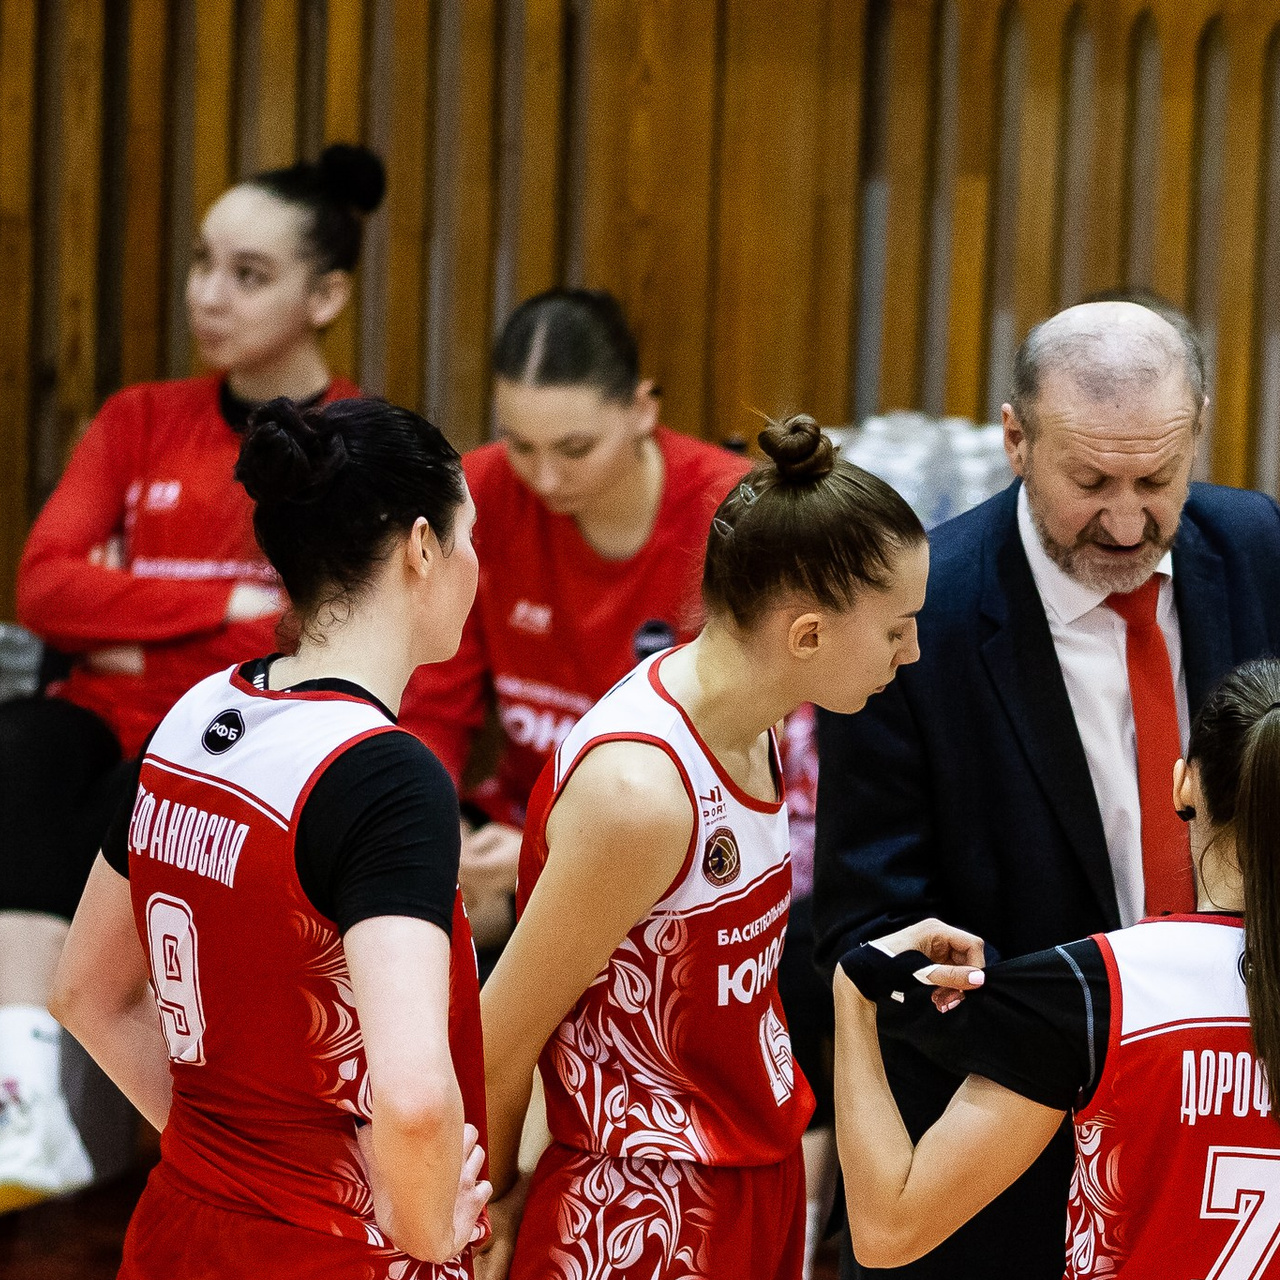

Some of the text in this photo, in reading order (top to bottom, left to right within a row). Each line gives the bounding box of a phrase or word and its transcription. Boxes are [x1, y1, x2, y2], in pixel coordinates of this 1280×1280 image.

[208, 722, 239, 741] РФБ
[703, 803, 727, 818] PORT
[146, 892, 206, 1066] 9
